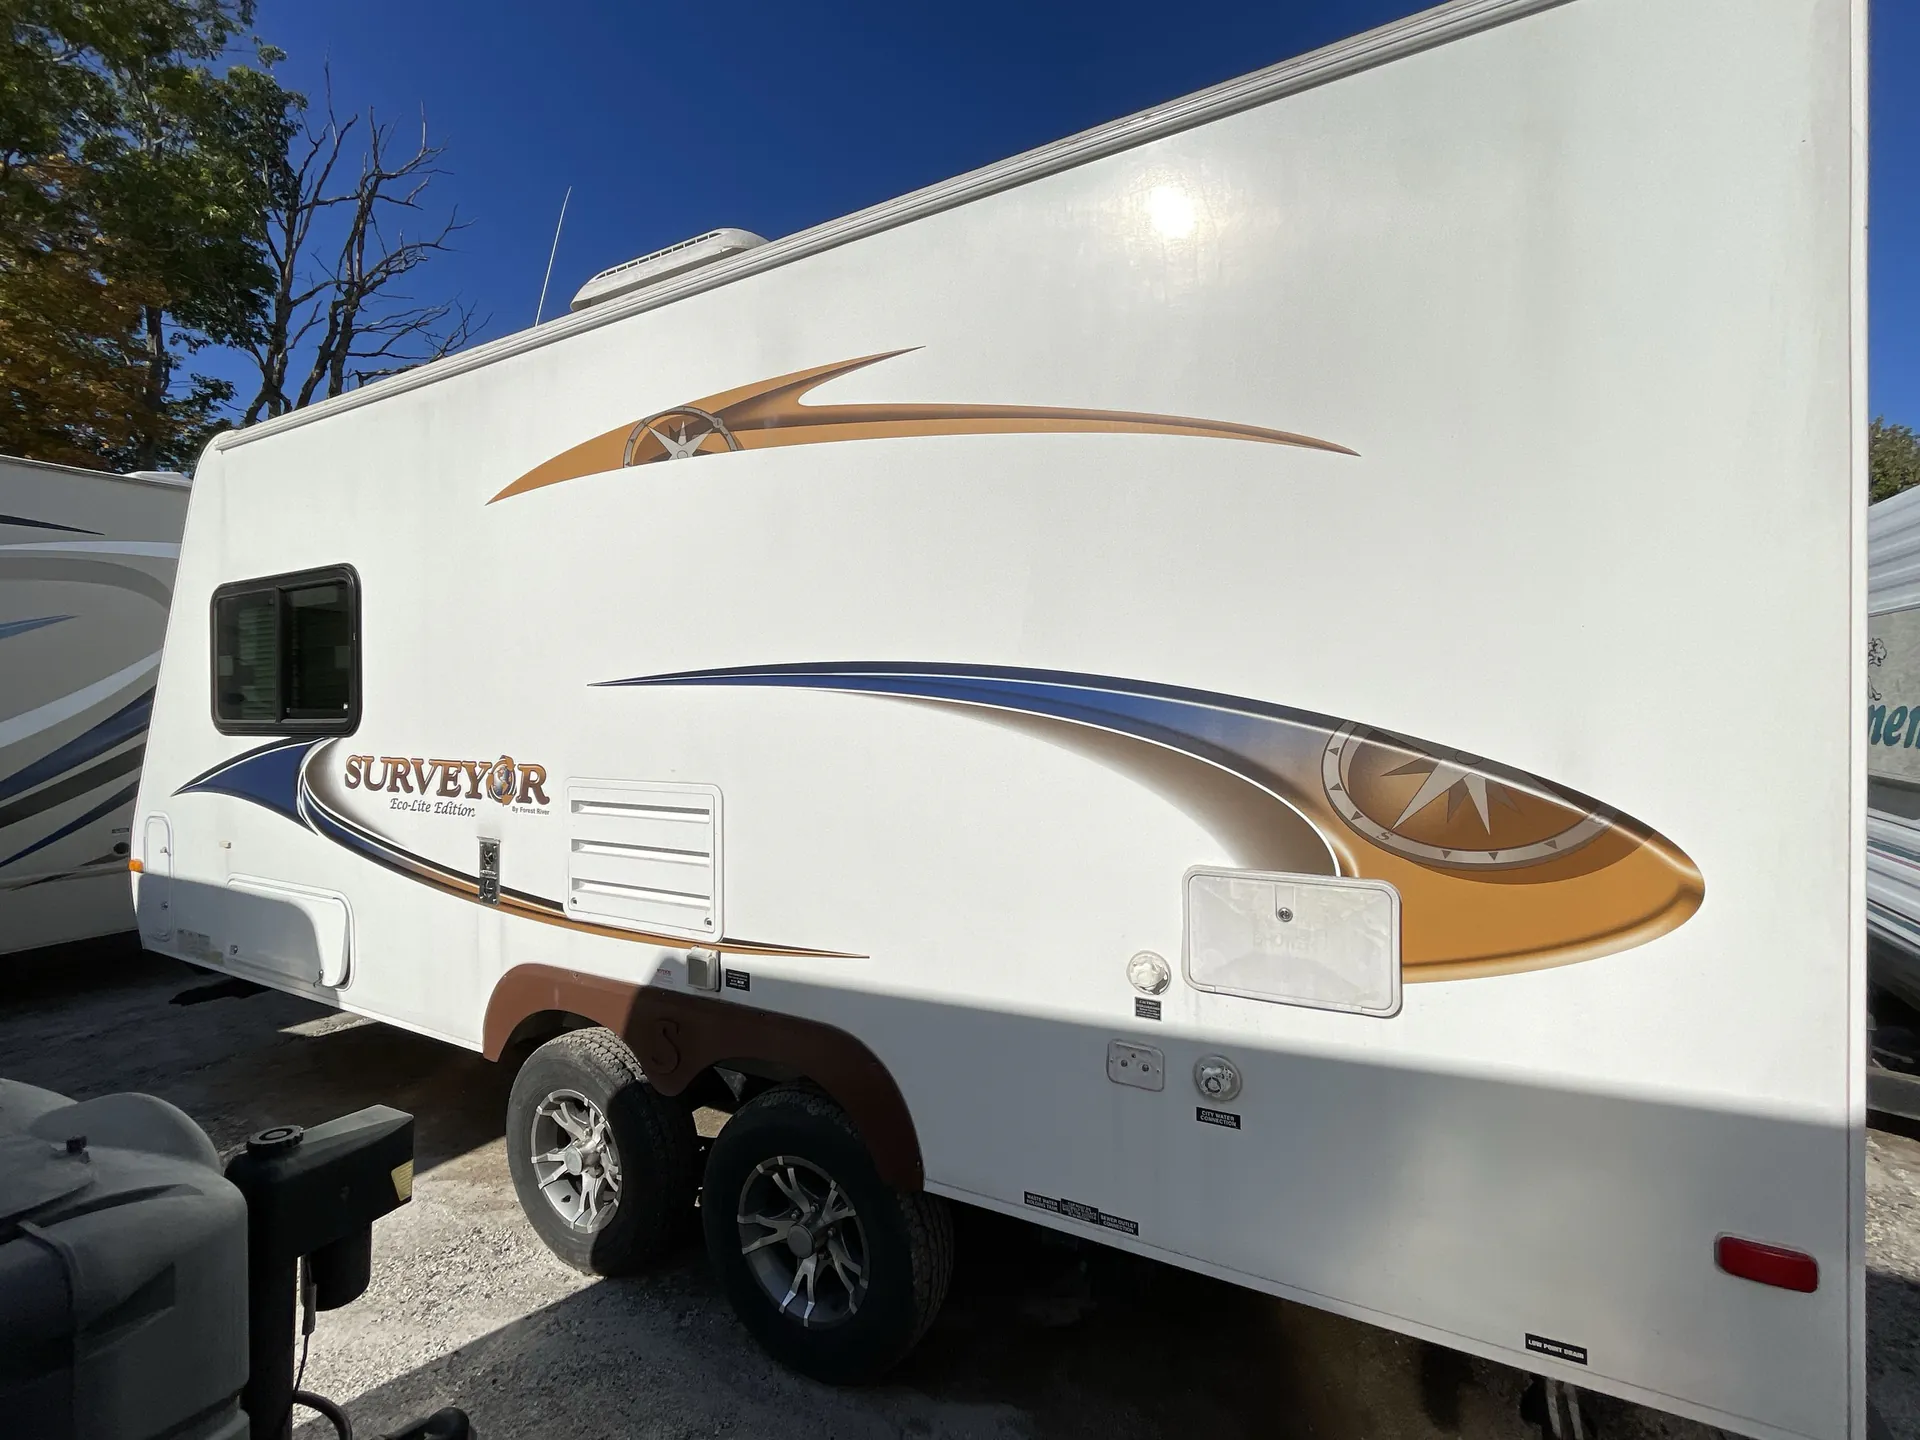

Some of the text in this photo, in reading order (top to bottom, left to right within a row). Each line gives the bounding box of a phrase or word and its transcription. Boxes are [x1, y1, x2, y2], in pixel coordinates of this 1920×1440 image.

[344, 754, 551, 807] SURVEYOR
[389, 797, 476, 817] Eco-Lite Edition
[511, 805, 550, 816] By Forest River
[1200, 1115, 1237, 1126] CONNECTION
[1214, 1112, 1235, 1122] WATER
[1026, 1194, 1058, 1207] WASTE WATER
[1100, 1214, 1136, 1229] SEWER OUTLET
[1103, 1221, 1134, 1233] CONNECTION
[1528, 1340, 1584, 1358] LOW POINT DRAIN
